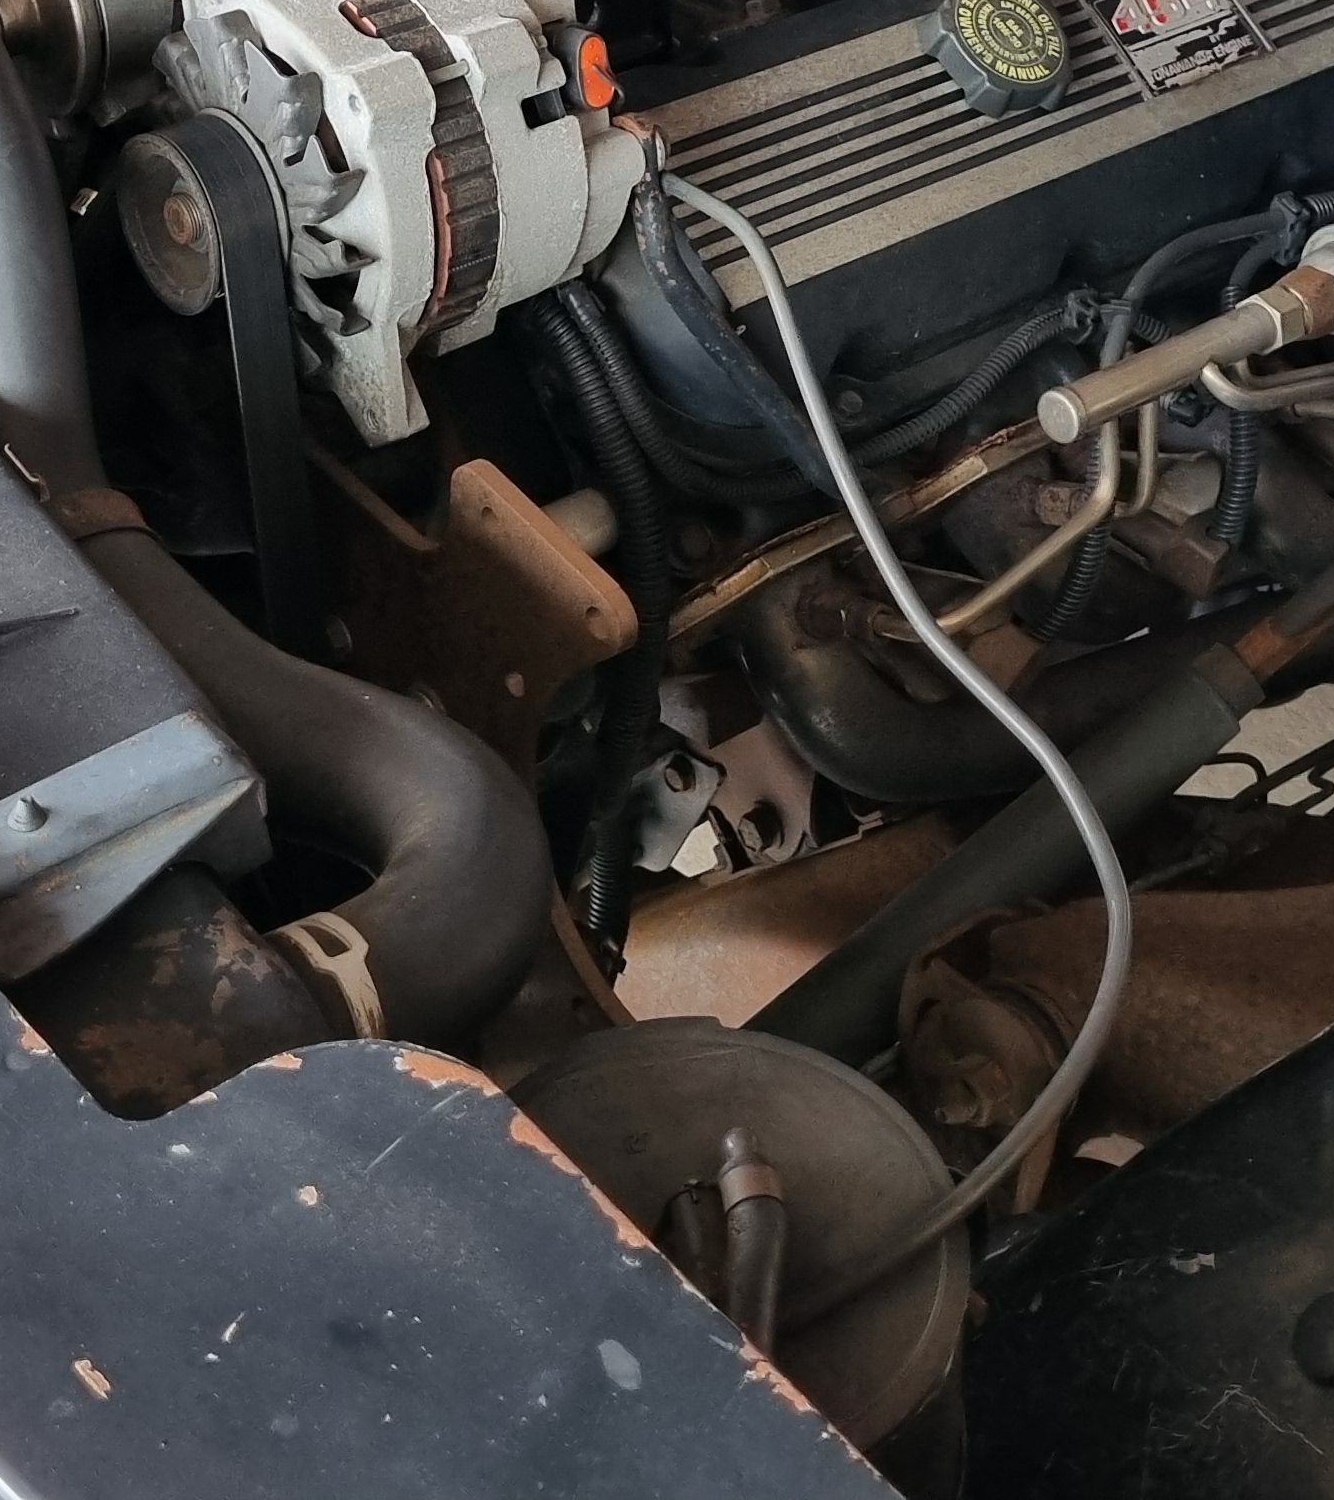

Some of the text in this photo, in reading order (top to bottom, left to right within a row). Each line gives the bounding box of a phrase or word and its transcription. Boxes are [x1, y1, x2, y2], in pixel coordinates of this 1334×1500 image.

[960, 7, 995, 64] OWNER'S
[995, 59, 1050, 79] MANUAL
[992, 16, 1022, 47] 10W-30
[1037, 13, 1054, 31] OIL
[1047, 36, 1059, 57] FILL
[1213, 34, 1254, 57] ENGINE
